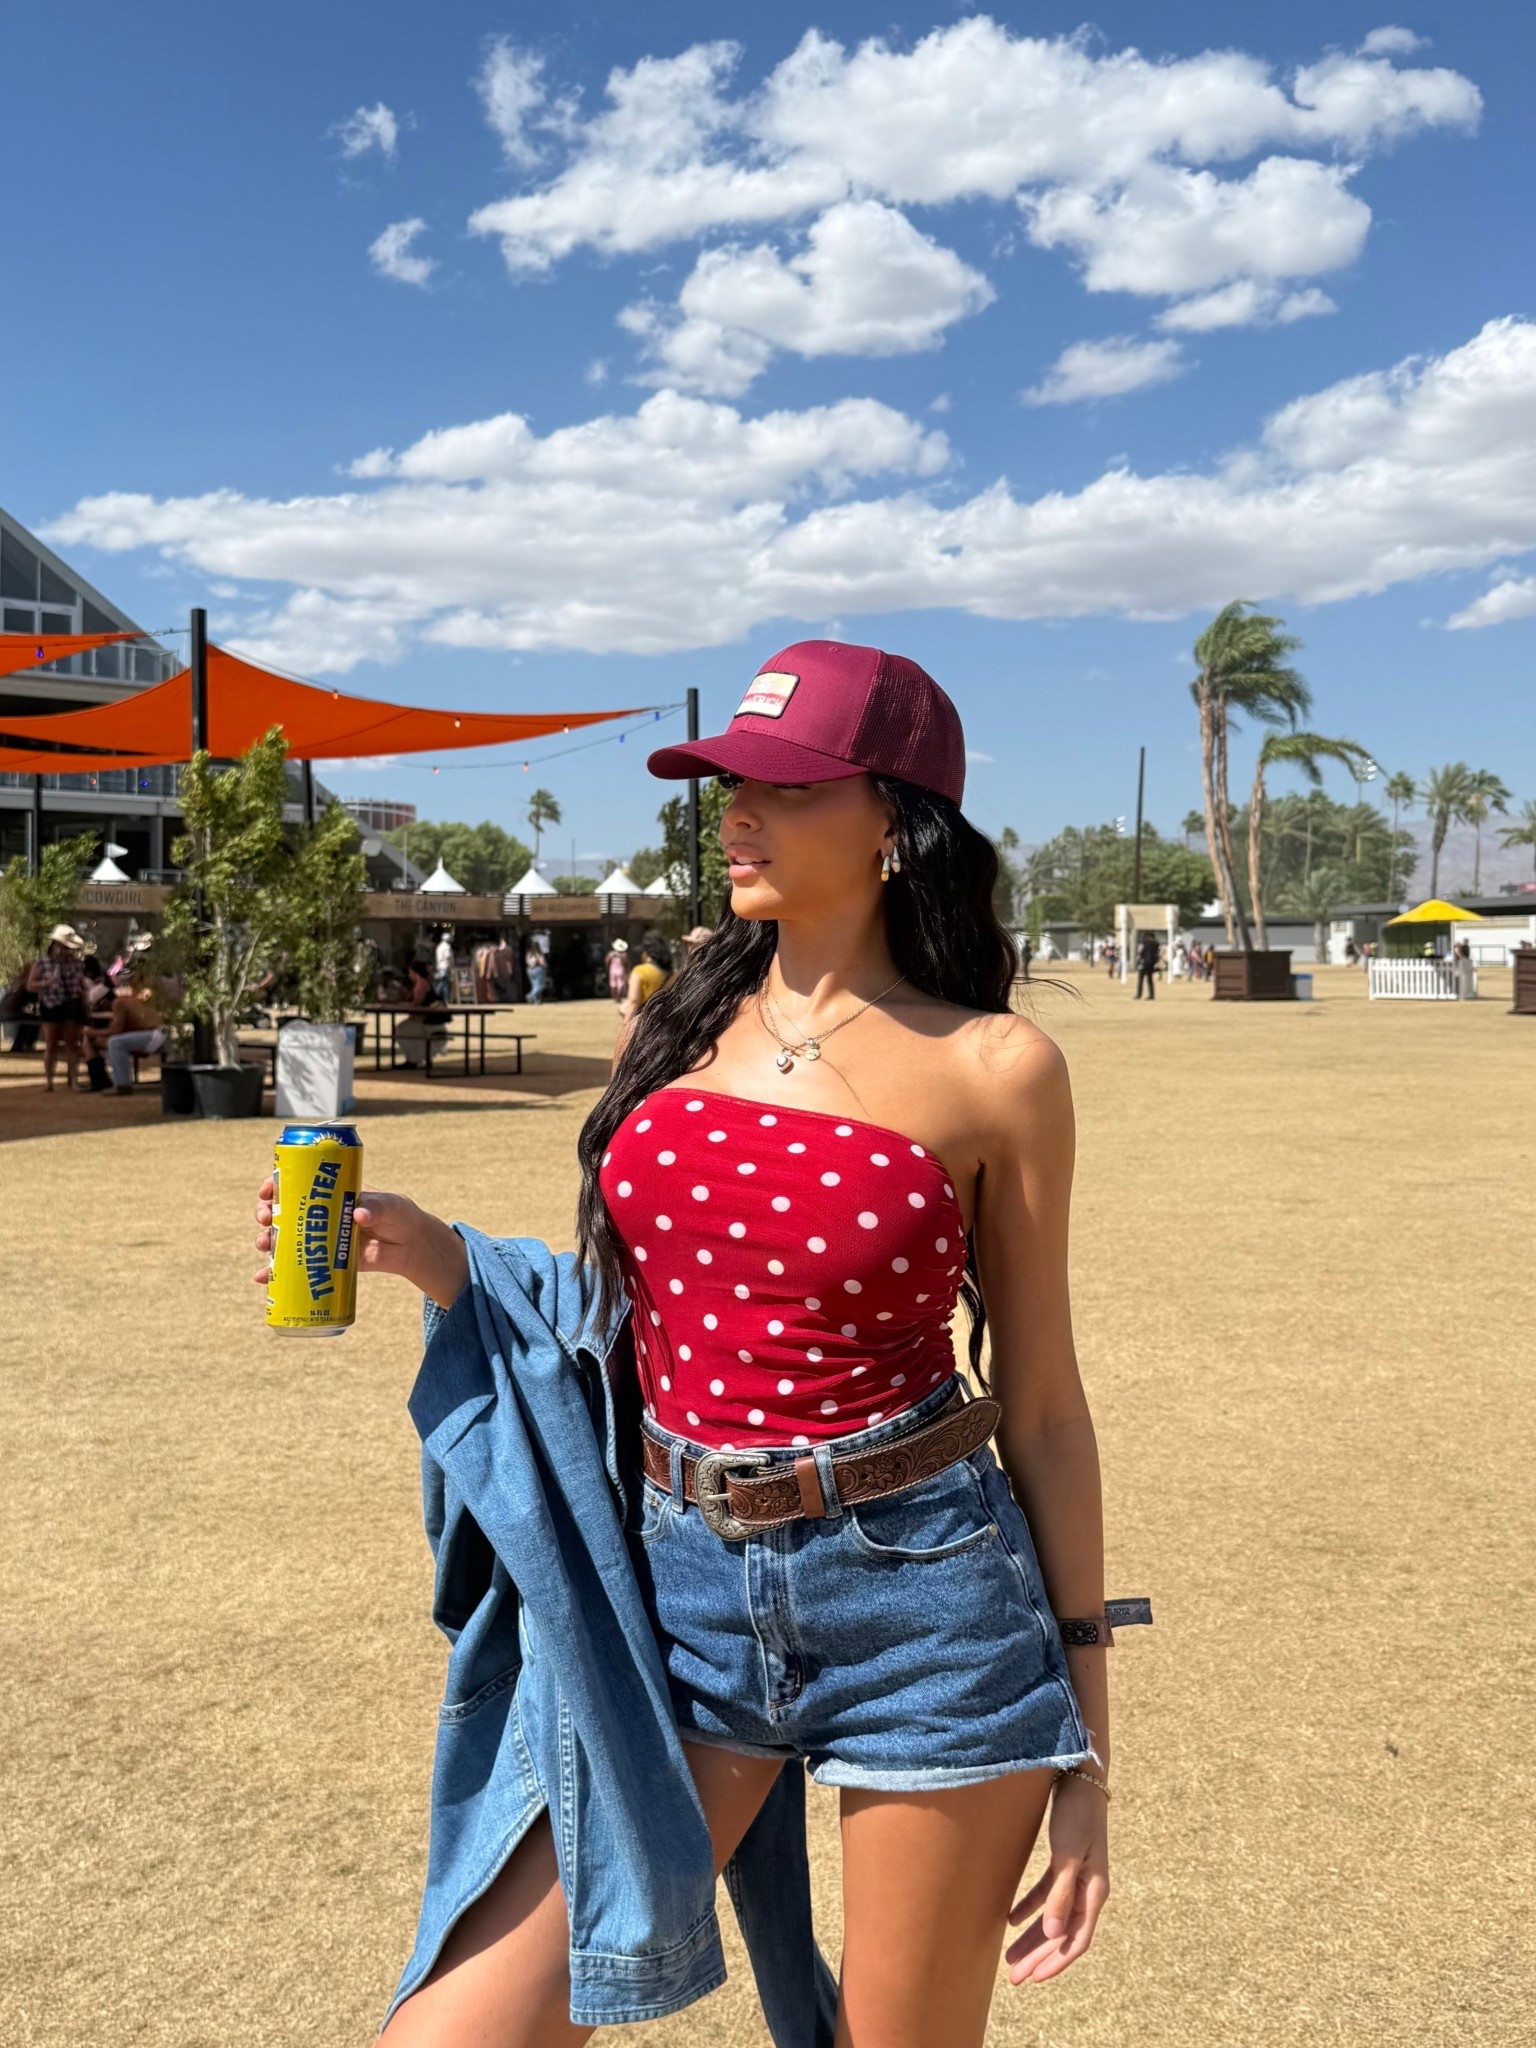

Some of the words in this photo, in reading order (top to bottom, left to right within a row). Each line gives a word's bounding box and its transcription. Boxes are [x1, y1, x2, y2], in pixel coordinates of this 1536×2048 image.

[86, 891, 142, 905] COWGIRL
[415, 899, 457, 914] CANYON
[309, 1161, 342, 1200] TEA
[299, 1195, 307, 1212] TEA
[337, 1199, 354, 1261] ORIGINAL
[296, 1240, 304, 1266] HARD
[304, 1204, 335, 1301] TWISTED
